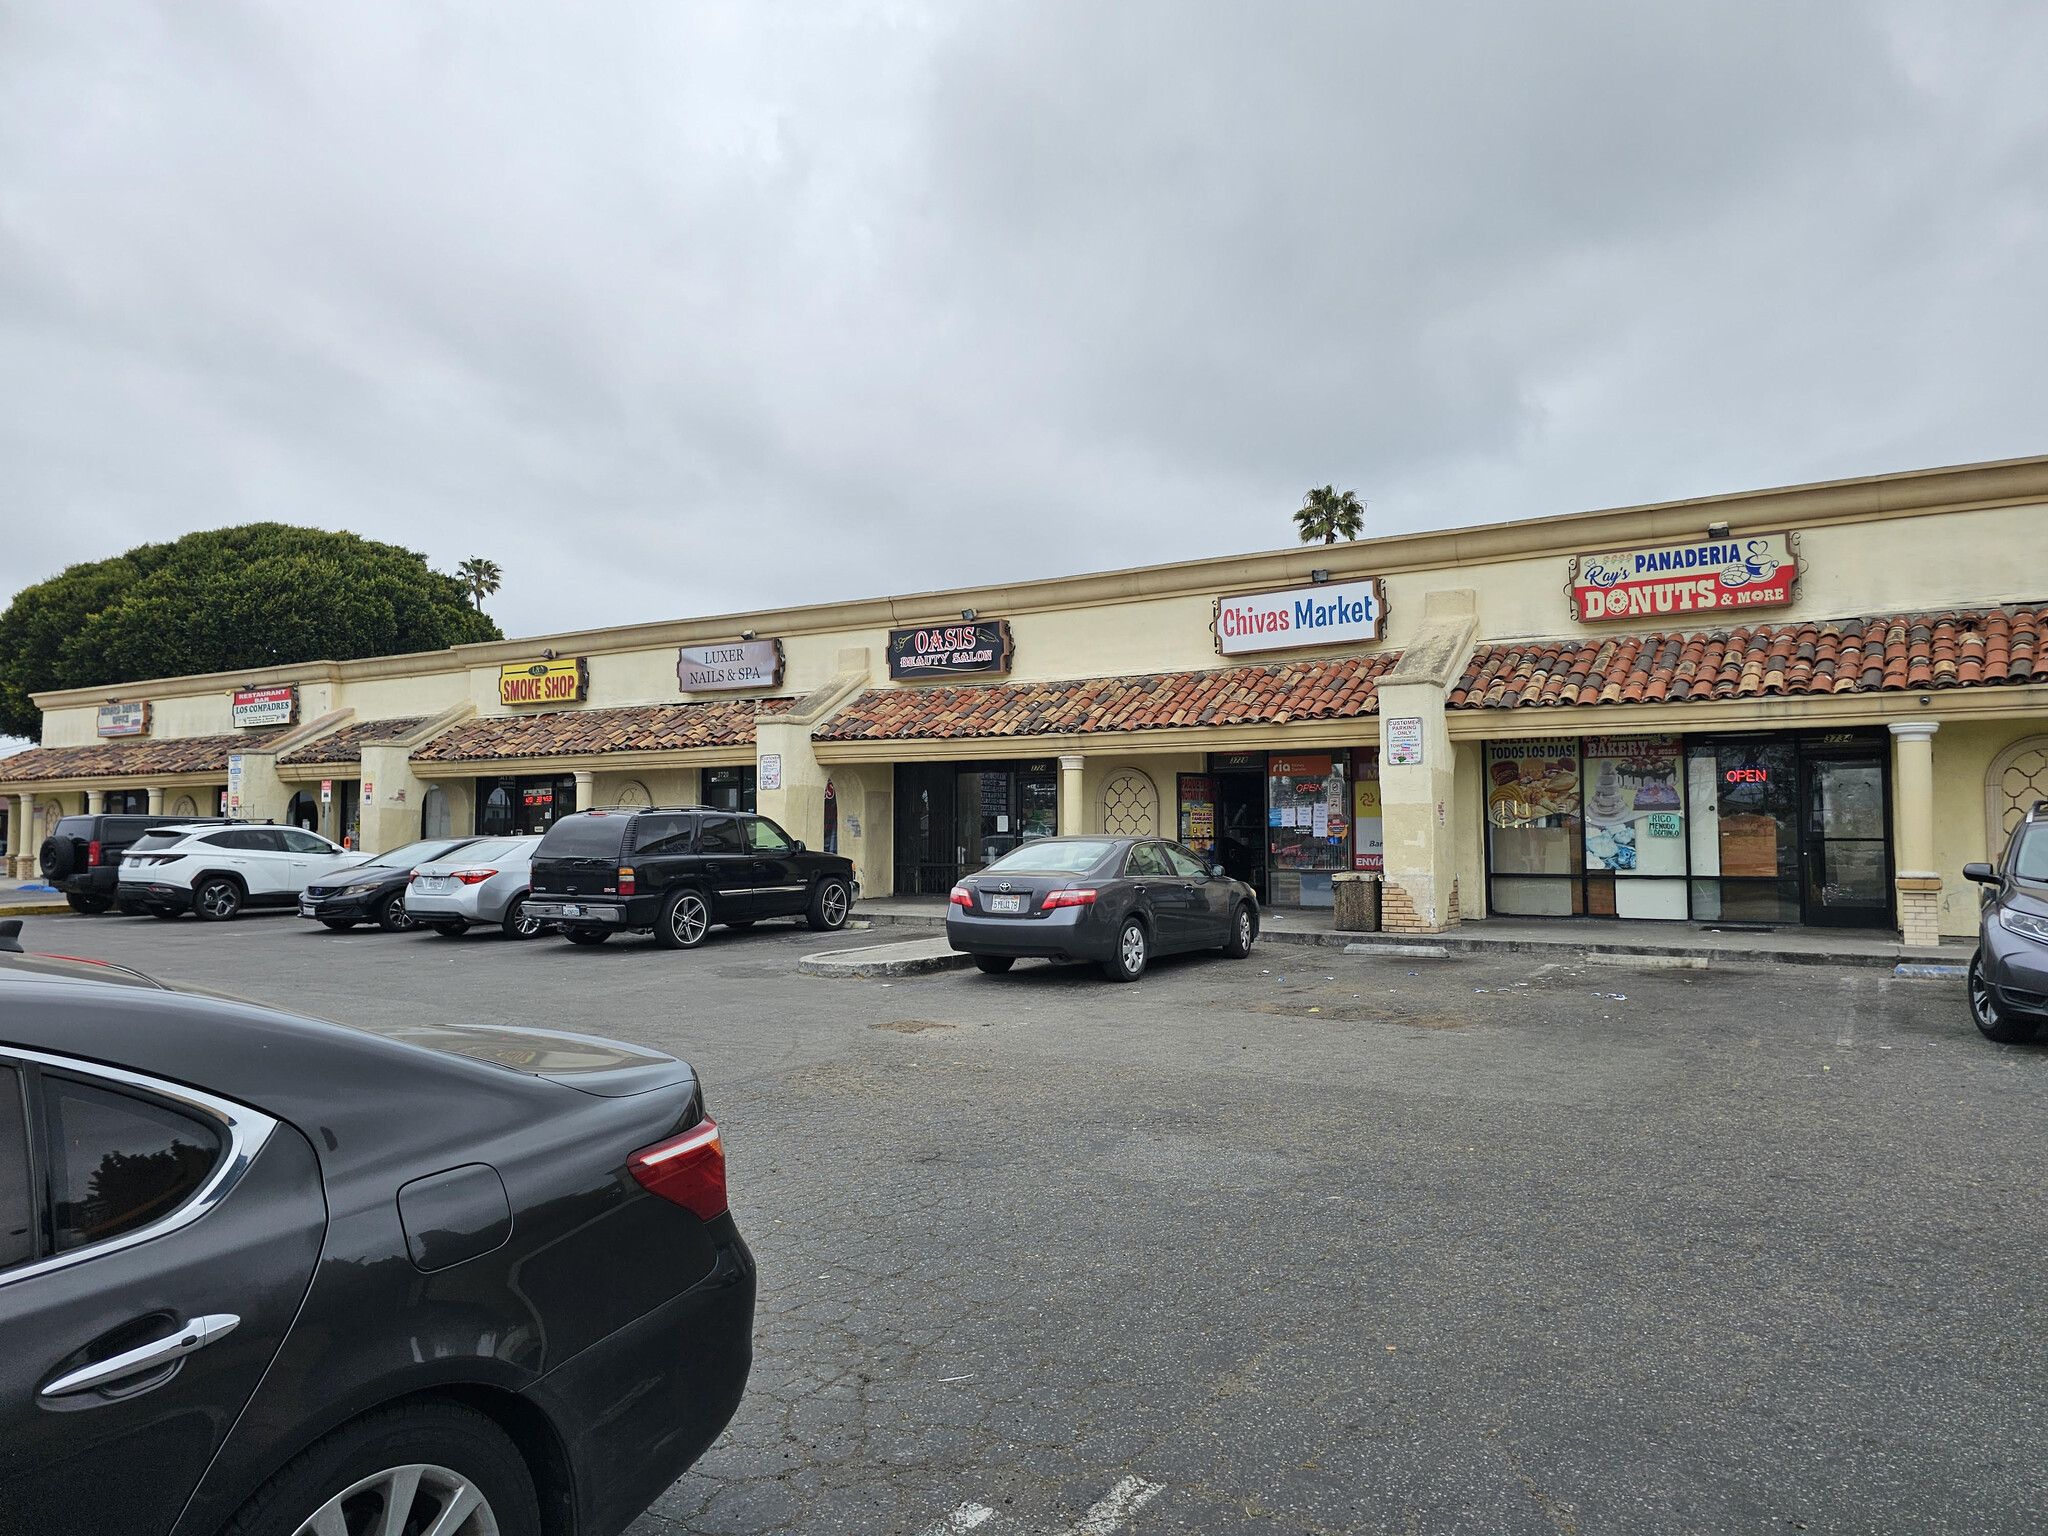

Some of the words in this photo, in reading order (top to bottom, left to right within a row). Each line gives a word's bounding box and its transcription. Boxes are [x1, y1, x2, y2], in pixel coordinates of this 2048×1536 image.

[1584, 565, 1630, 588] Ray's
[1635, 544, 1741, 573] PANADERIA
[1585, 579, 1716, 618] DONUTS
[1720, 592, 1733, 606] &
[1737, 588, 1784, 604] MORE
[1223, 607, 1290, 637] Chivas
[1295, 595, 1373, 629] Market
[914, 626, 976, 654] OASIS
[704, 648, 745, 664] LUXER
[900, 651, 950, 668] BEAUTY
[952, 650, 993, 663] SALON
[689, 669, 725, 684] NAILS
[727, 669, 735, 681] &
[738, 667, 760, 680] SPA
[238, 689, 286, 699] RESTAURANT
[503, 678, 541, 702] SMOKE
[544, 675, 575, 698] SHOP
[236, 705, 248, 714] LOS
[249, 701, 289, 713] COMPADRES
[1490, 746, 1524, 759] TODOS
[1527, 745, 1545, 758] LOS
[1547, 744, 1575, 758] DIAS!
[1587, 741, 1649, 757] BAKERY
[1273, 760, 1291, 772] ria
[1726, 769, 1767, 782] OPEN
[1296, 784, 1322, 792] OPEN
[1649, 822, 1676, 830] MENUDO
[1652, 815, 1672, 823] RICO
